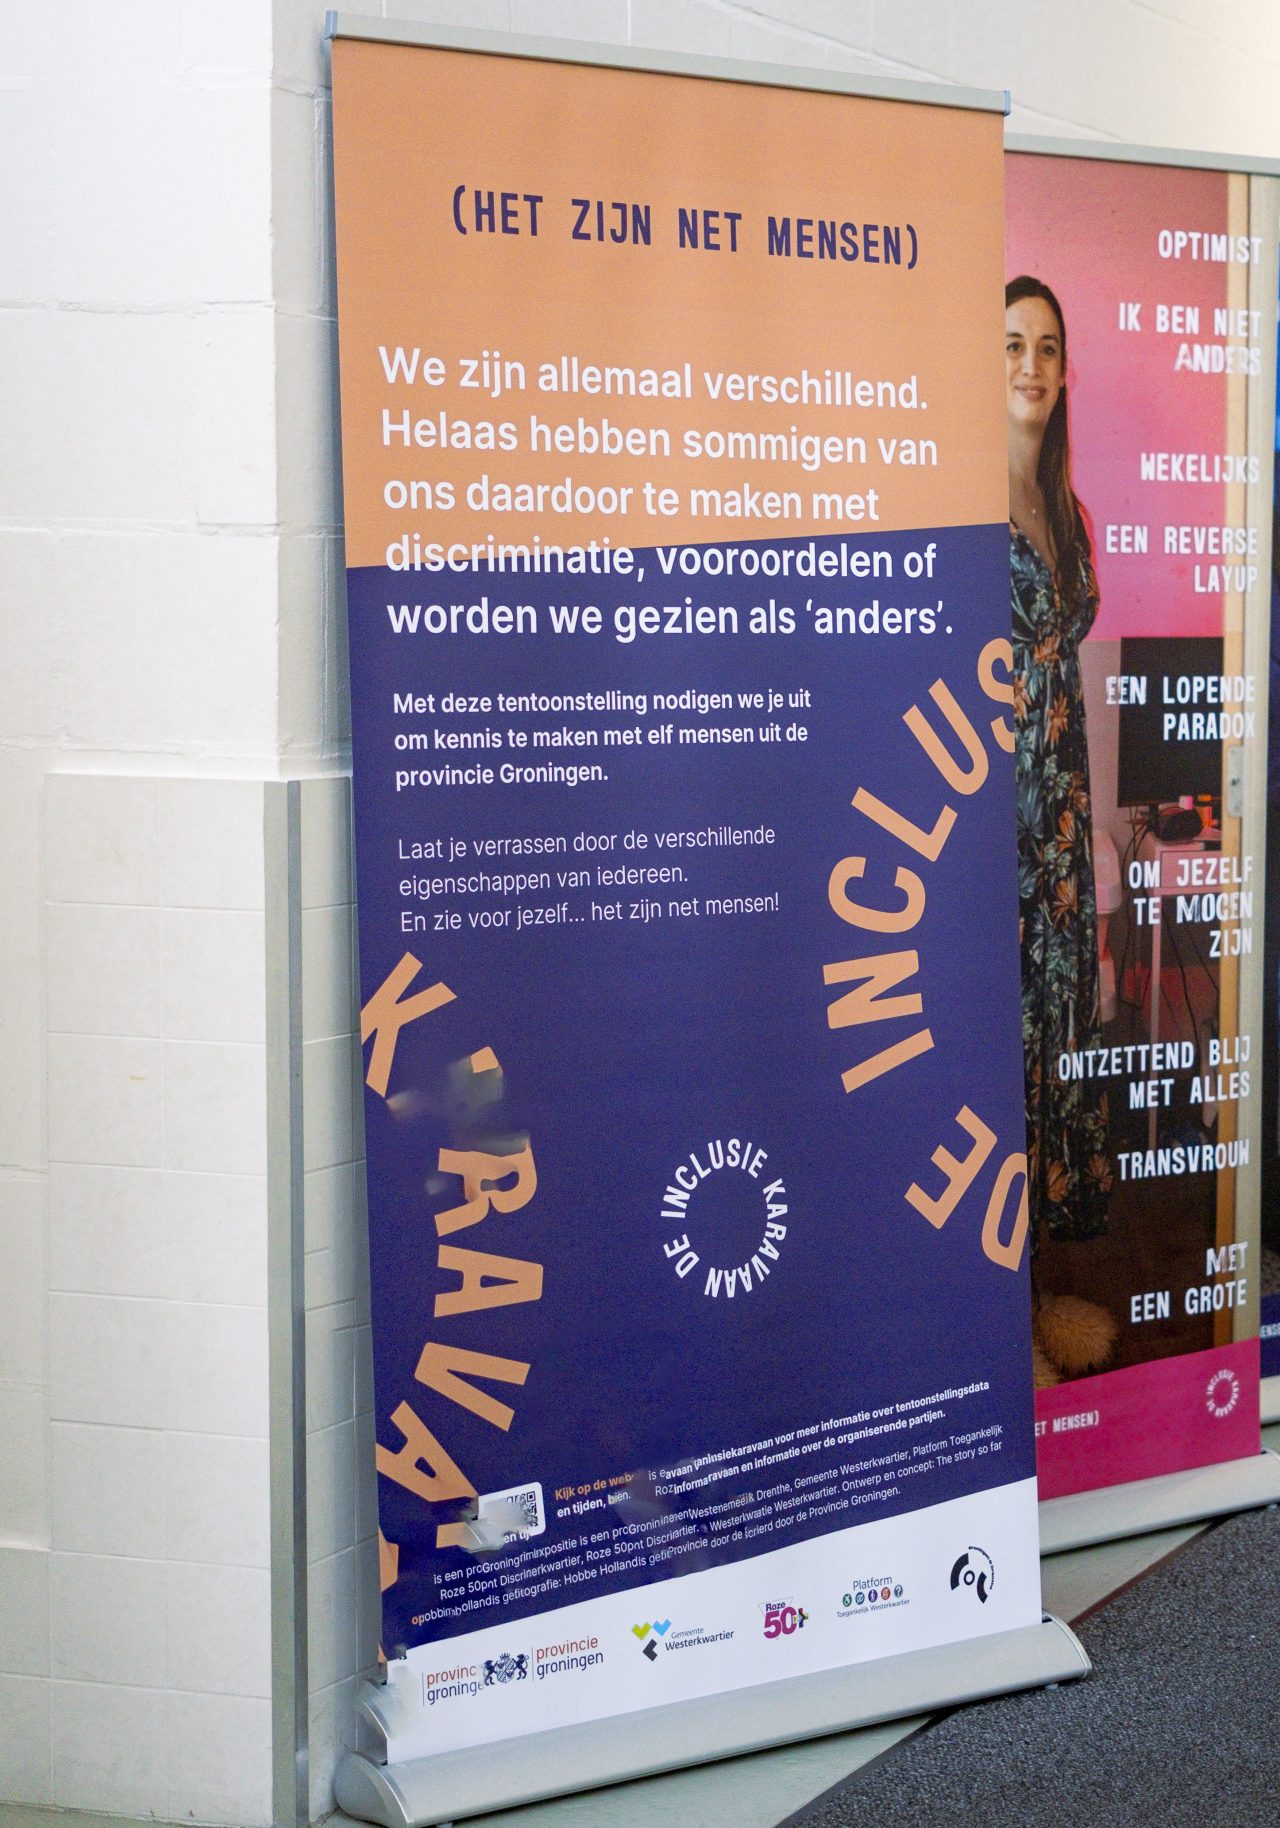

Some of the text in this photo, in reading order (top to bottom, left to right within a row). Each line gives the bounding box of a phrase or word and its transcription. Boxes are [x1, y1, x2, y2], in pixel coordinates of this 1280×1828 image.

[453, 184, 919, 270] (HET ZIJN NET MENSEN)
[1158, 230, 1263, 264] OPTIMIST
[1119, 302, 1261, 337] IK BEN NIET
[1175, 343, 1261, 375] ANDERS
[378, 344, 929, 410] We zijn allemaal verschillend.
[382, 409, 938, 472] Helaas hebben sommigen van
[1140, 453, 1260, 483] WEKELIJKS
[383, 475, 879, 520] ons daardoor te maken met
[1106, 524, 1258, 555] EEN REVERSE
[385, 534, 938, 583] discriminatie, vooroordelen of
[1194, 564, 1258, 594] LAYUP
[386, 597, 538, 636] worden
[549, 605, 603, 636] we
[614, 598, 739, 644] gezien
[748, 598, 796, 635] als
[393, 688, 811, 715] Met deze tentoonstelling nodigen we je uit
[1105, 675, 1255, 706] EEN LOPENDE
[394, 722, 808, 751] om kennis te maken met elf mensen uit de
[1163, 712, 1255, 742] PARADOX
[395, 761, 609, 792] provincie Groningen.
[398, 825, 775, 861] Laat je verrassen door de verschillende
[399, 862, 689, 902] eigenschappen van iedereen.
[1128, 855, 1253, 890] OM JEZELF
[400, 892, 780, 933] En zie voor jezelf... het zijn net mensen!
[1134, 892, 1253, 926] TE MOGEN
[1209, 928, 1252, 958] ZIJN
[1058, 1035, 1251, 1082] ONTZETTEND BLIJ
[1129, 1071, 1250, 1110] MET ALLES
[1118, 1138, 1249, 1181] TRANSVROUW
[660, 1138, 788, 1298] DE INCLUSIE KARAVAAN
[1205, 1241, 1248, 1276] MET
[1130, 1279, 1246, 1324] EEN GROTE
[774, 1380, 990, 1446] voor meer informatie over tentoonstellingsdata
[1053, 1409, 1100, 1434] MENSEN)
[755, 1446, 800, 1468] informatie
[801, 1440, 821, 1455] over
[837, 1419, 907, 1444] organiserende
[908, 1409, 946, 1429] partijen.
[757, 1424, 1003, 1501] Drenthe, Gemeente Westerkwartier, Platform Toegankelijk
[774, 1440, 1002, 1512] Westerkwartier. Ontwerp en concept: The story so far
[555, 1487, 576, 1501] Kijk
[572, 1498, 606, 1515] tijden,
[809, 1486, 901, 1519] Provincie Groningen.
[853, 1575, 893, 1592] Platform
[766, 1601, 786, 1612] Roze
[535, 1635, 599, 1664] provincie
[665, 1630, 735, 1652] Westerkwartier
[671, 1626, 704, 1639] Gemeente
[536, 1651, 604, 1680] groningen
